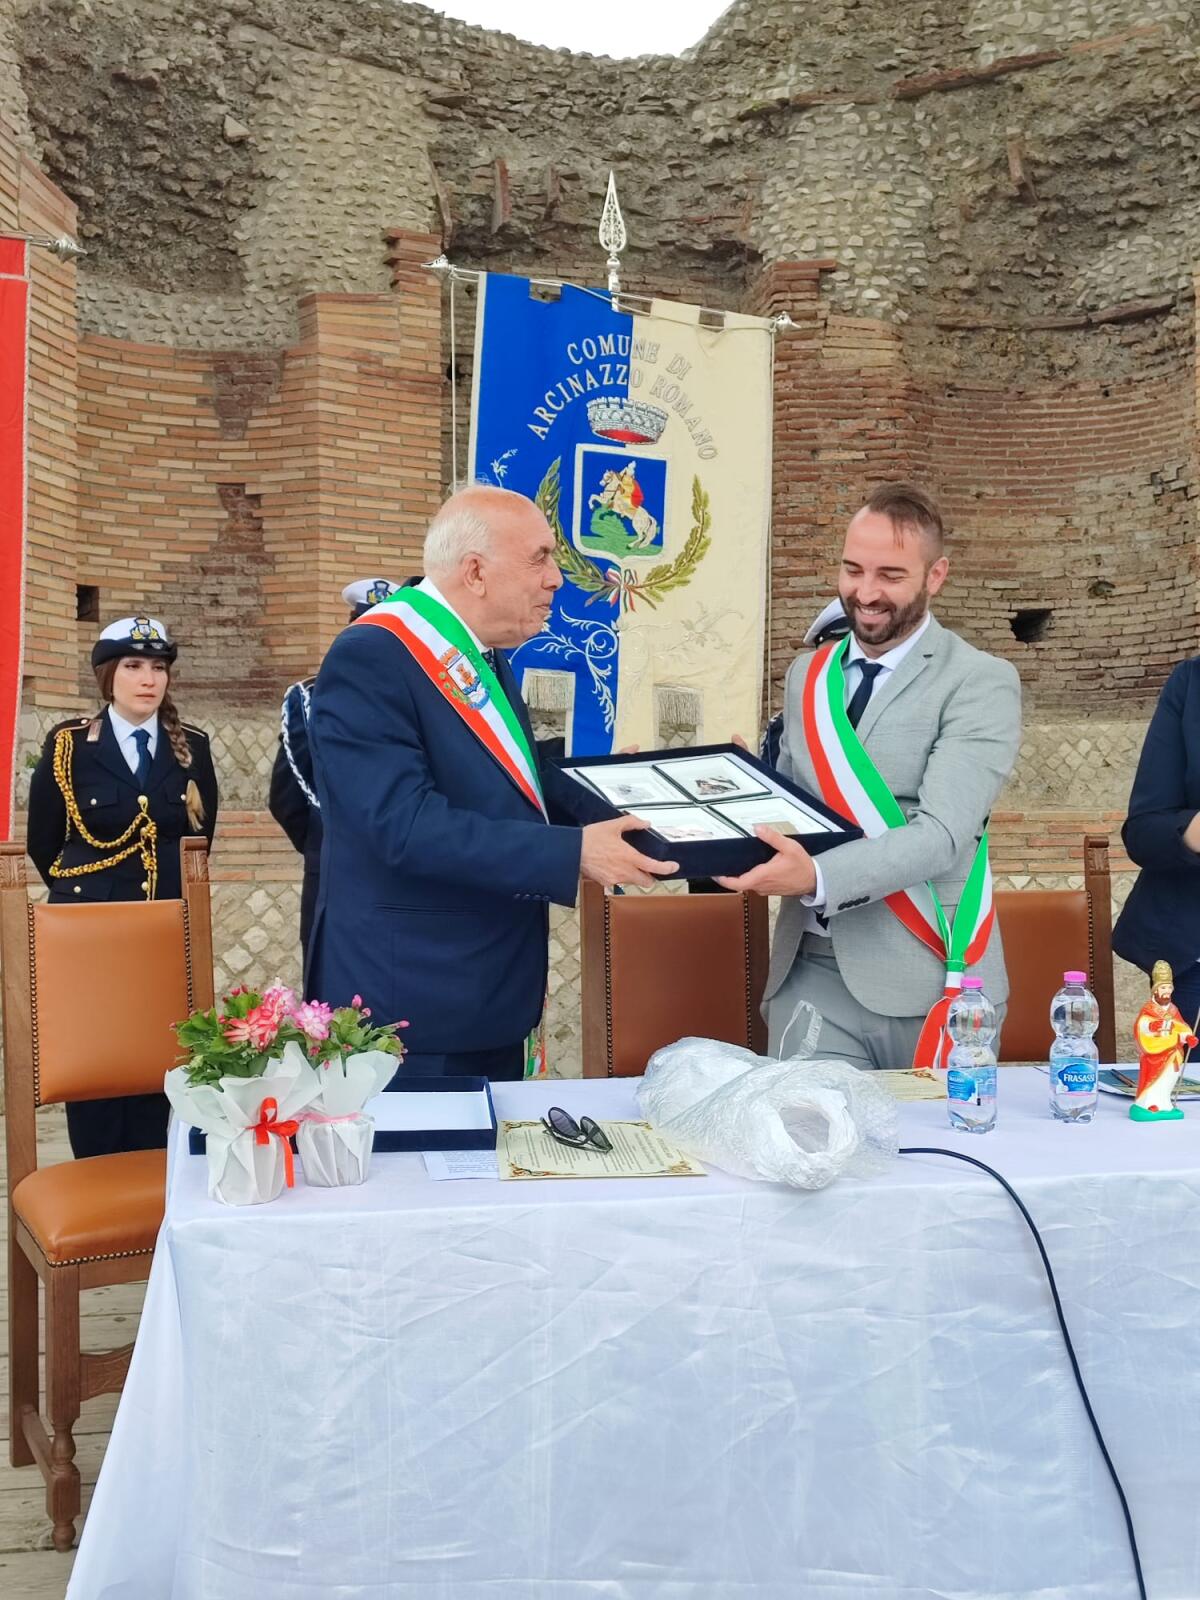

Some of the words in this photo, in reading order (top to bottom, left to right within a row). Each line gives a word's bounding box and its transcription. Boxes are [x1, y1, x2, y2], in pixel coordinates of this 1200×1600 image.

[567, 333, 661, 365] COMUNE
[666, 352, 693, 380] DI
[527, 363, 644, 440] ARCINAZZO
[650, 374, 718, 460] ROMANO
